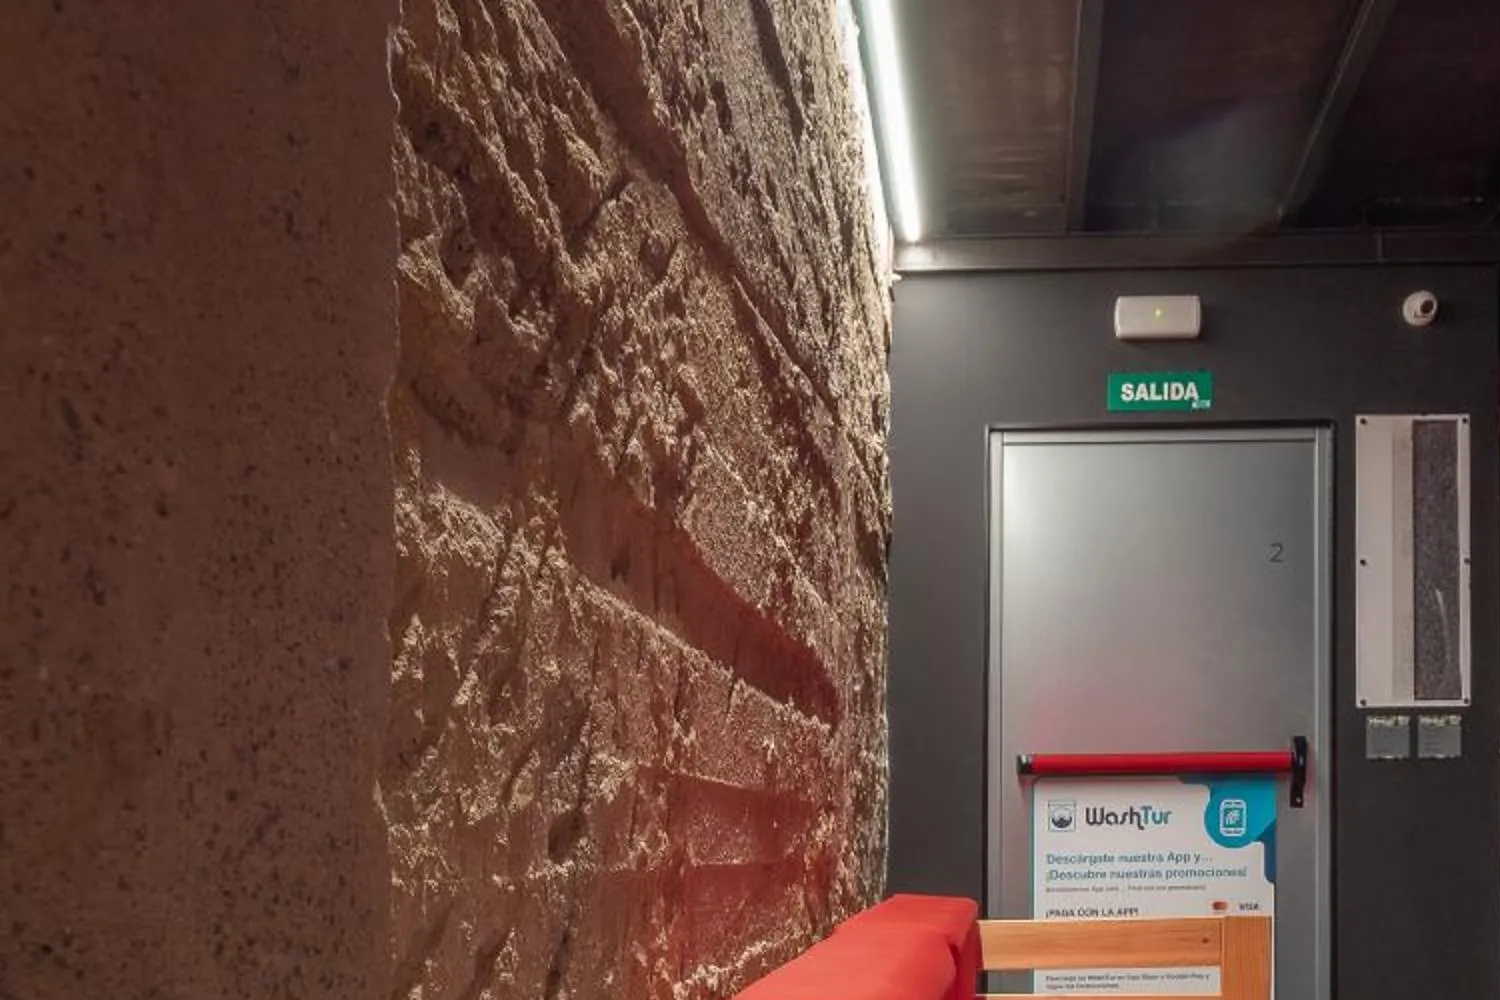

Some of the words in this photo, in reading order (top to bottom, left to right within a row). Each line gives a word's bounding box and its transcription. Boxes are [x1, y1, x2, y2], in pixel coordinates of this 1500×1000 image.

[1120, 382, 1199, 401] SALIDA
[1269, 542, 1285, 563] 2
[1085, 805, 1173, 831] WashTur
[1167, 851, 1192, 864] App
